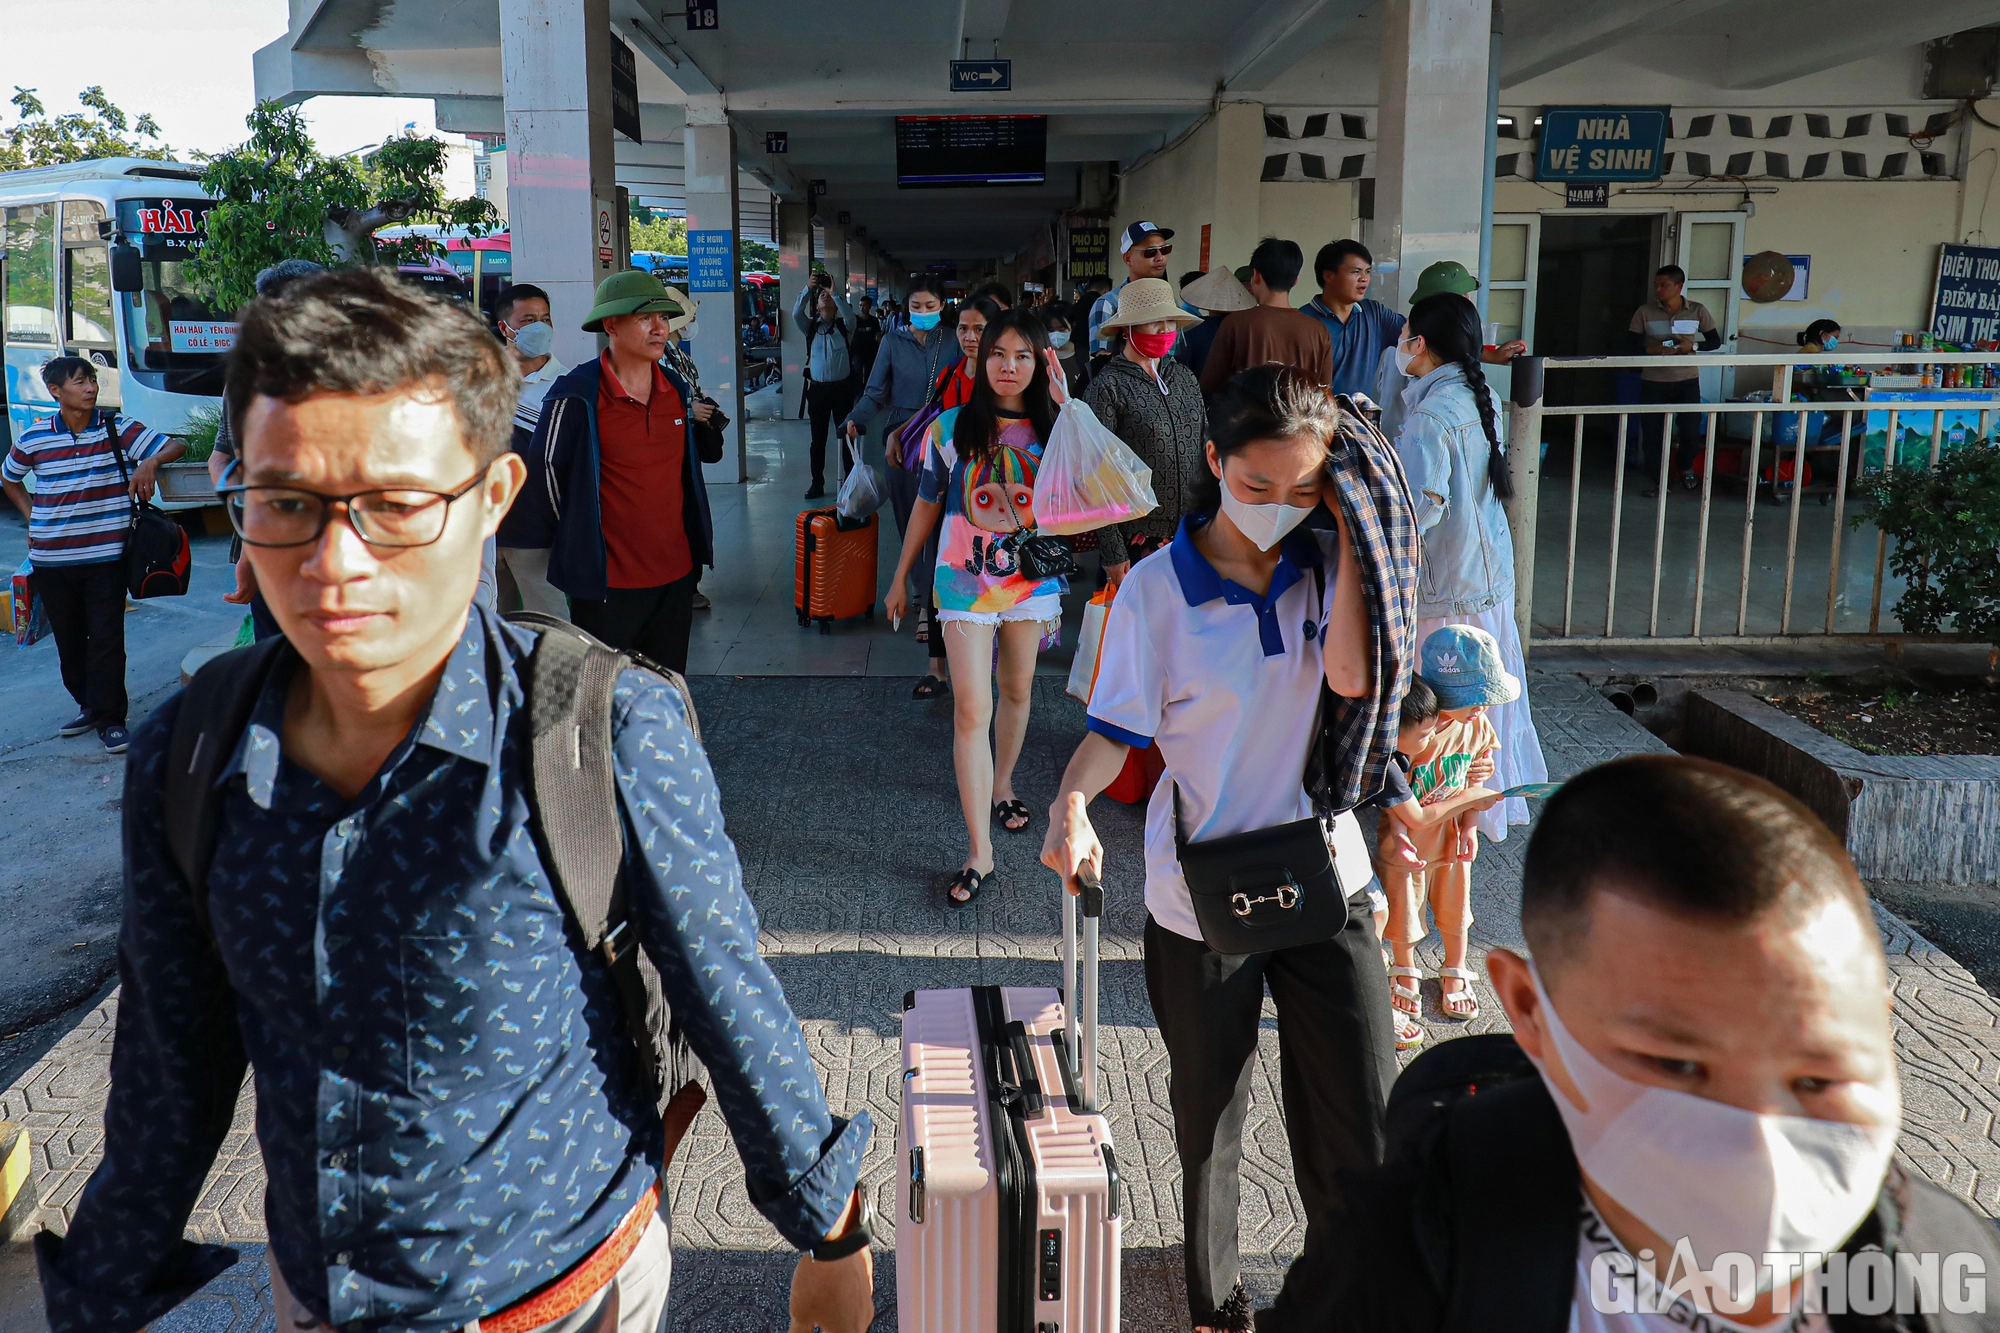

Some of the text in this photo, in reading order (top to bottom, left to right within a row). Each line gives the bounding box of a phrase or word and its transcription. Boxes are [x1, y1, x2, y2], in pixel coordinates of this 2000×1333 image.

[693, 8, 715, 27] 18
[959, 71, 979, 81] WC
[1576, 114, 1631, 140] NHÀ
[770, 139, 786, 152] 17
[1550, 144, 1653, 174] VỆ SINH
[813, 185, 825, 194] 16
[1568, 189, 1594, 202] NAM
[71, 215, 95, 225] SAMCO
[137, 199, 197, 233] HẢI
[841, 215, 850, 223] 15
[166, 239, 187, 248] B.X
[706, 235, 723, 245] NGHỊ
[706, 245, 729, 255] KHÁCH
[698, 255, 722, 266] KHÔNG
[1942, 251, 2000, 285] ĐIỆN THO
[1940, 282, 1978, 309] ĐIỂM
[209, 325, 223, 334] YÊN
[1934, 312, 2000, 343] SIM THẺ
